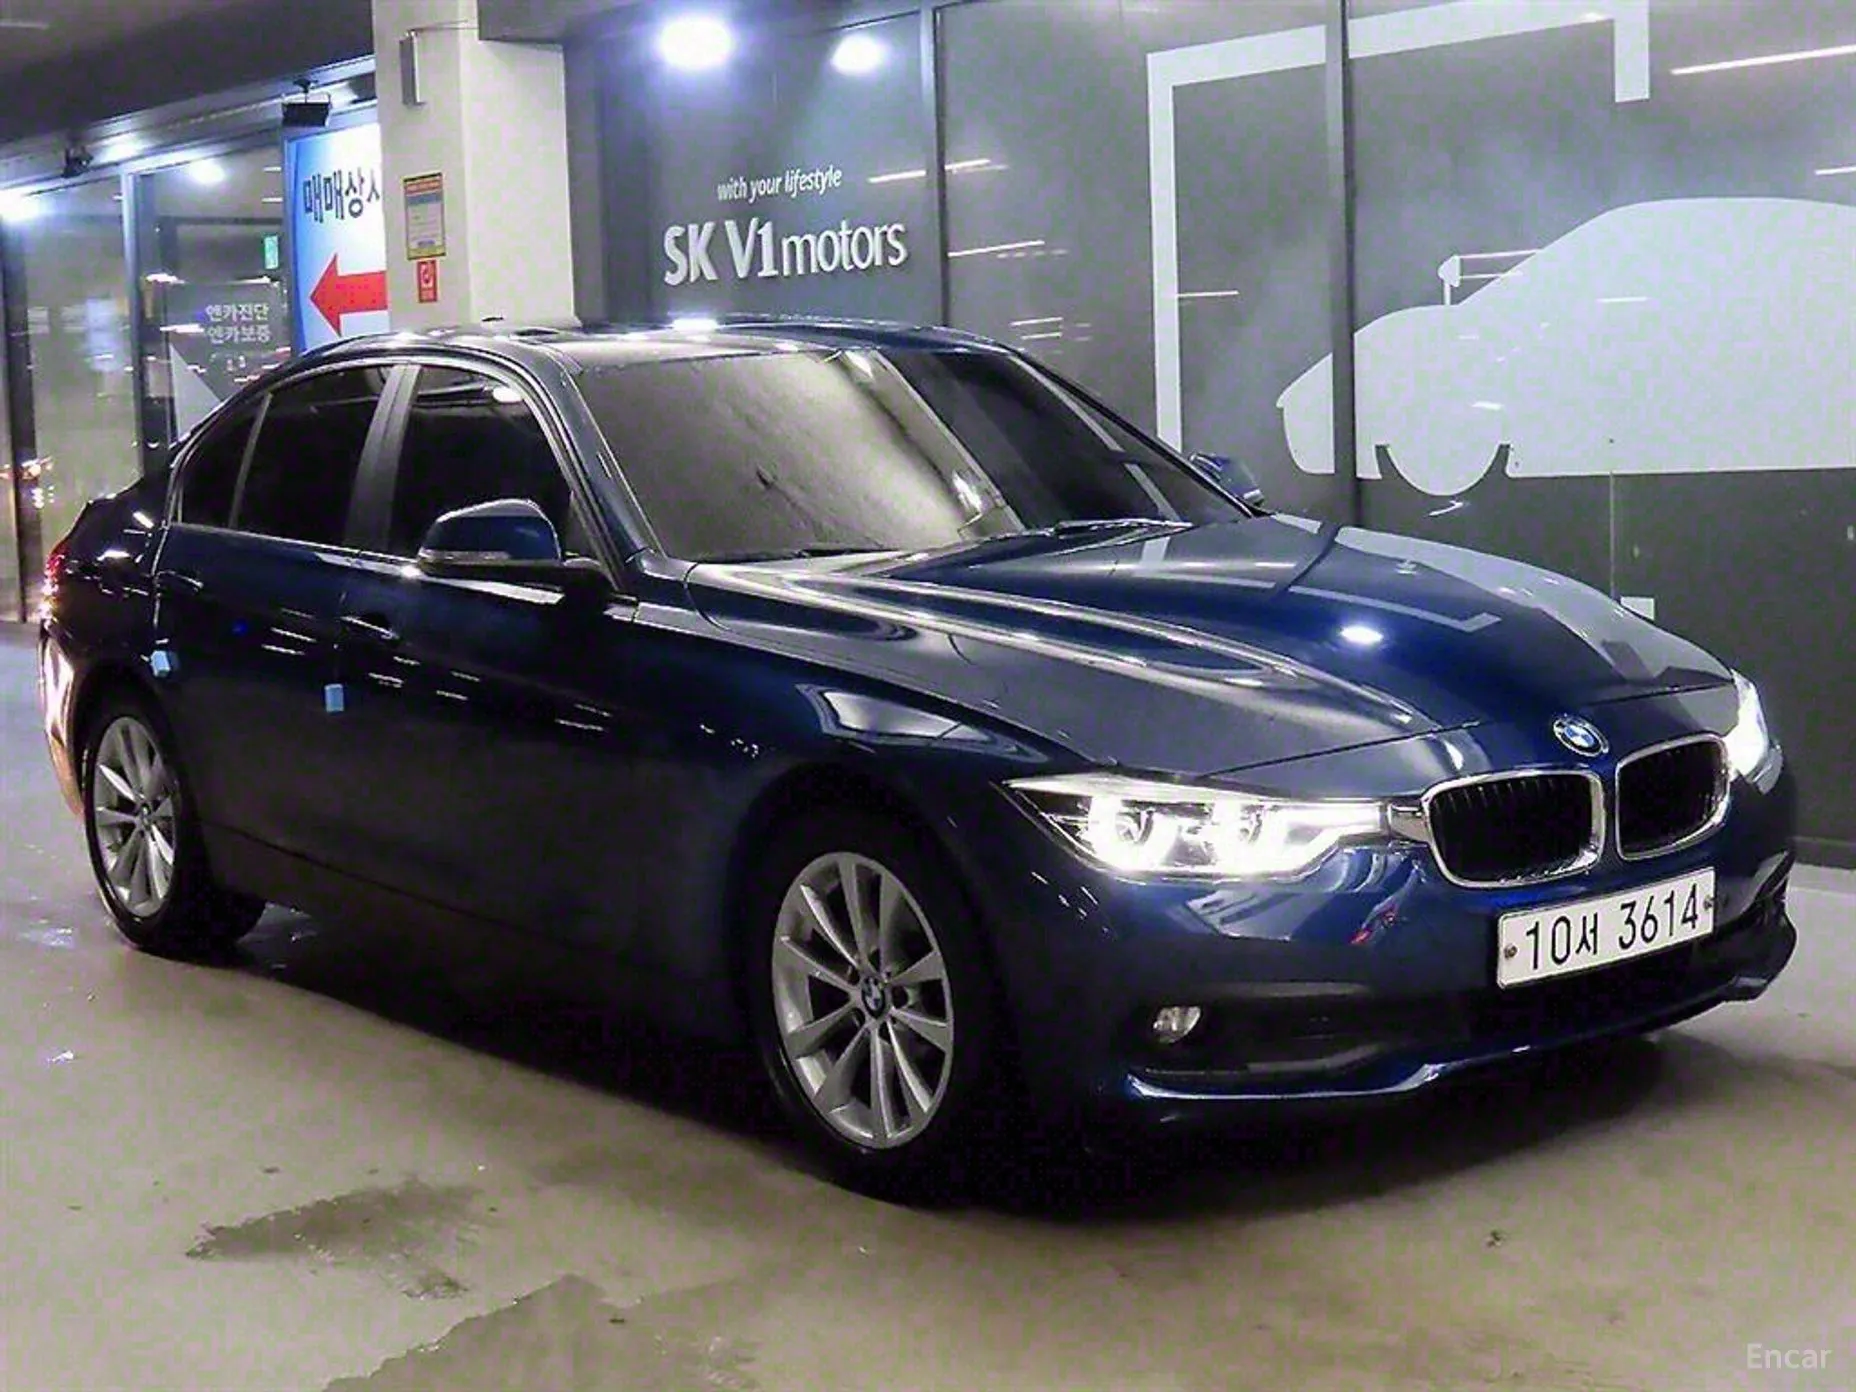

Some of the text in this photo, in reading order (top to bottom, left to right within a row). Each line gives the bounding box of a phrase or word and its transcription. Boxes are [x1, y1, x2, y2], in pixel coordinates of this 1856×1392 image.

[717, 164, 843, 204] with your lifestyle
[663, 220, 719, 286] SK
[1525, 883, 1699, 970] 10서 3614
